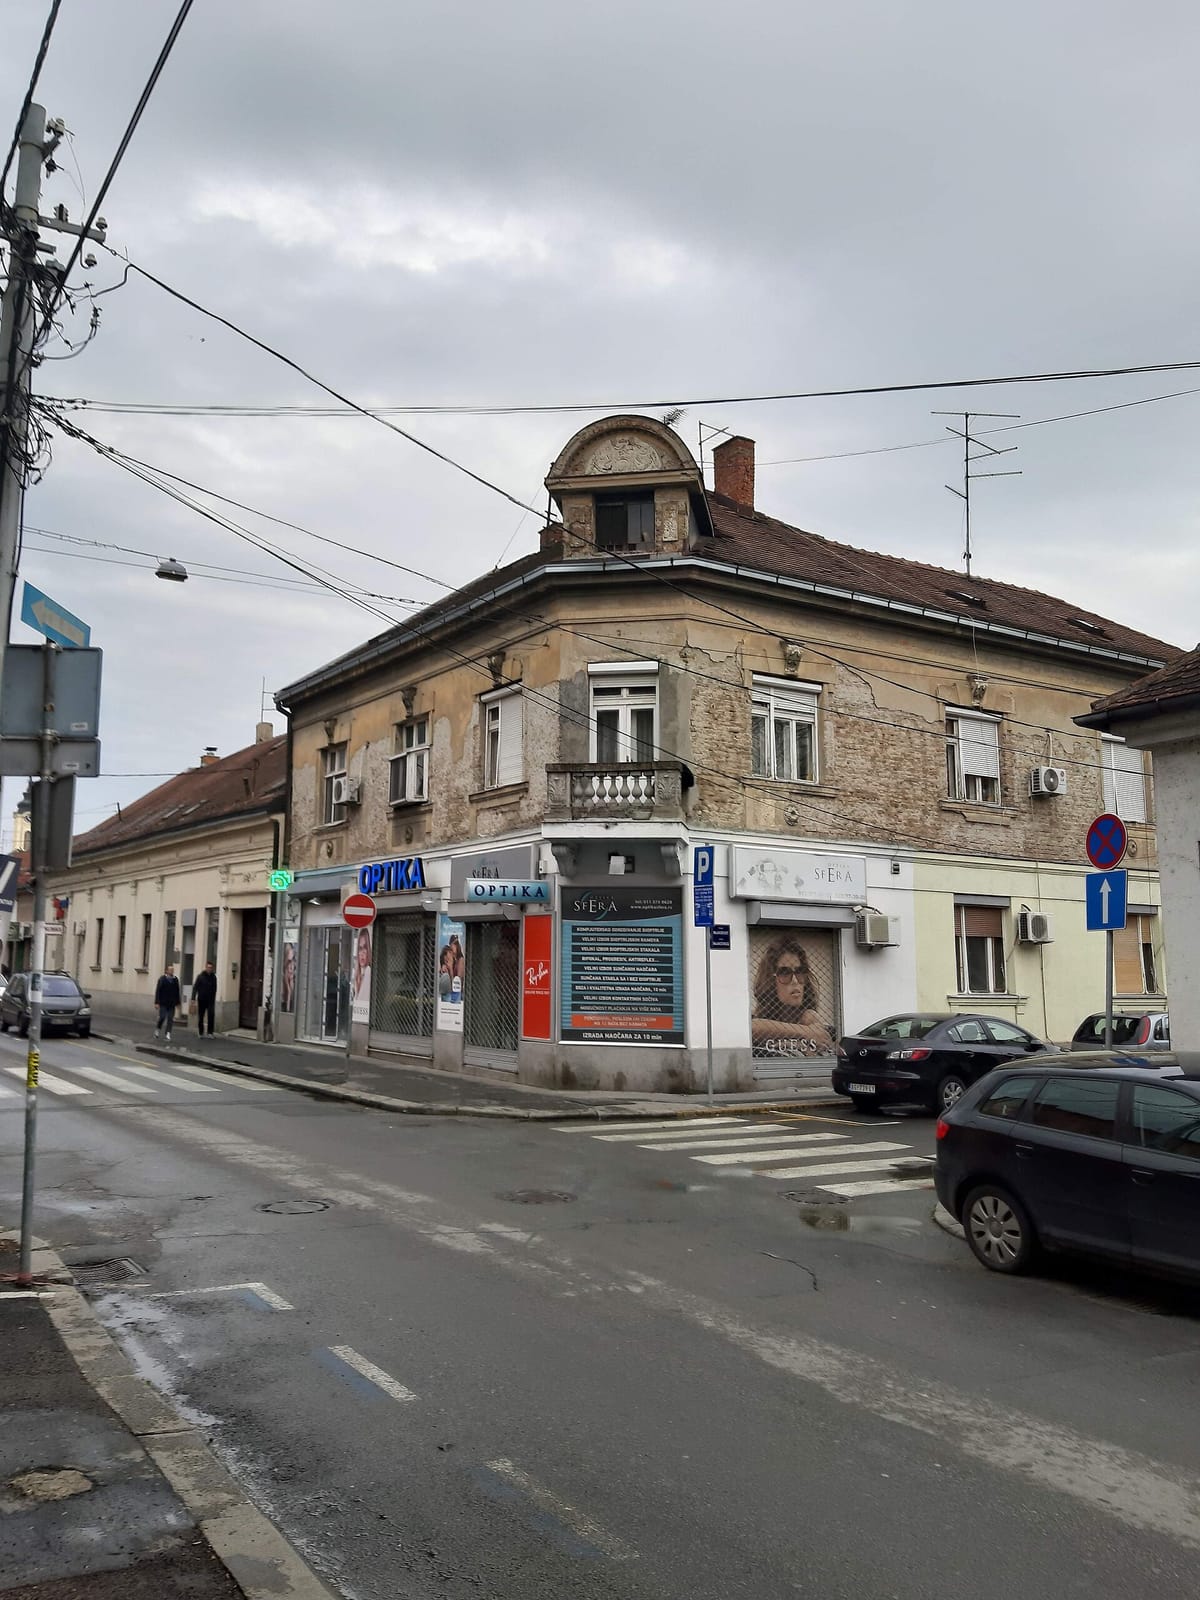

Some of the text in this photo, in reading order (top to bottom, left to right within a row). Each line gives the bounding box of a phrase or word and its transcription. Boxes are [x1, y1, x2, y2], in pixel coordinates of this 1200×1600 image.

[698, 851, 710, 882] P
[359, 857, 426, 894] OPTIKA
[814, 868, 852, 882] SFERA
[474, 884, 544, 897] OPTIKA
[574, 900, 618, 913] SFERA
[766, 1038, 816, 1052] GUESS
